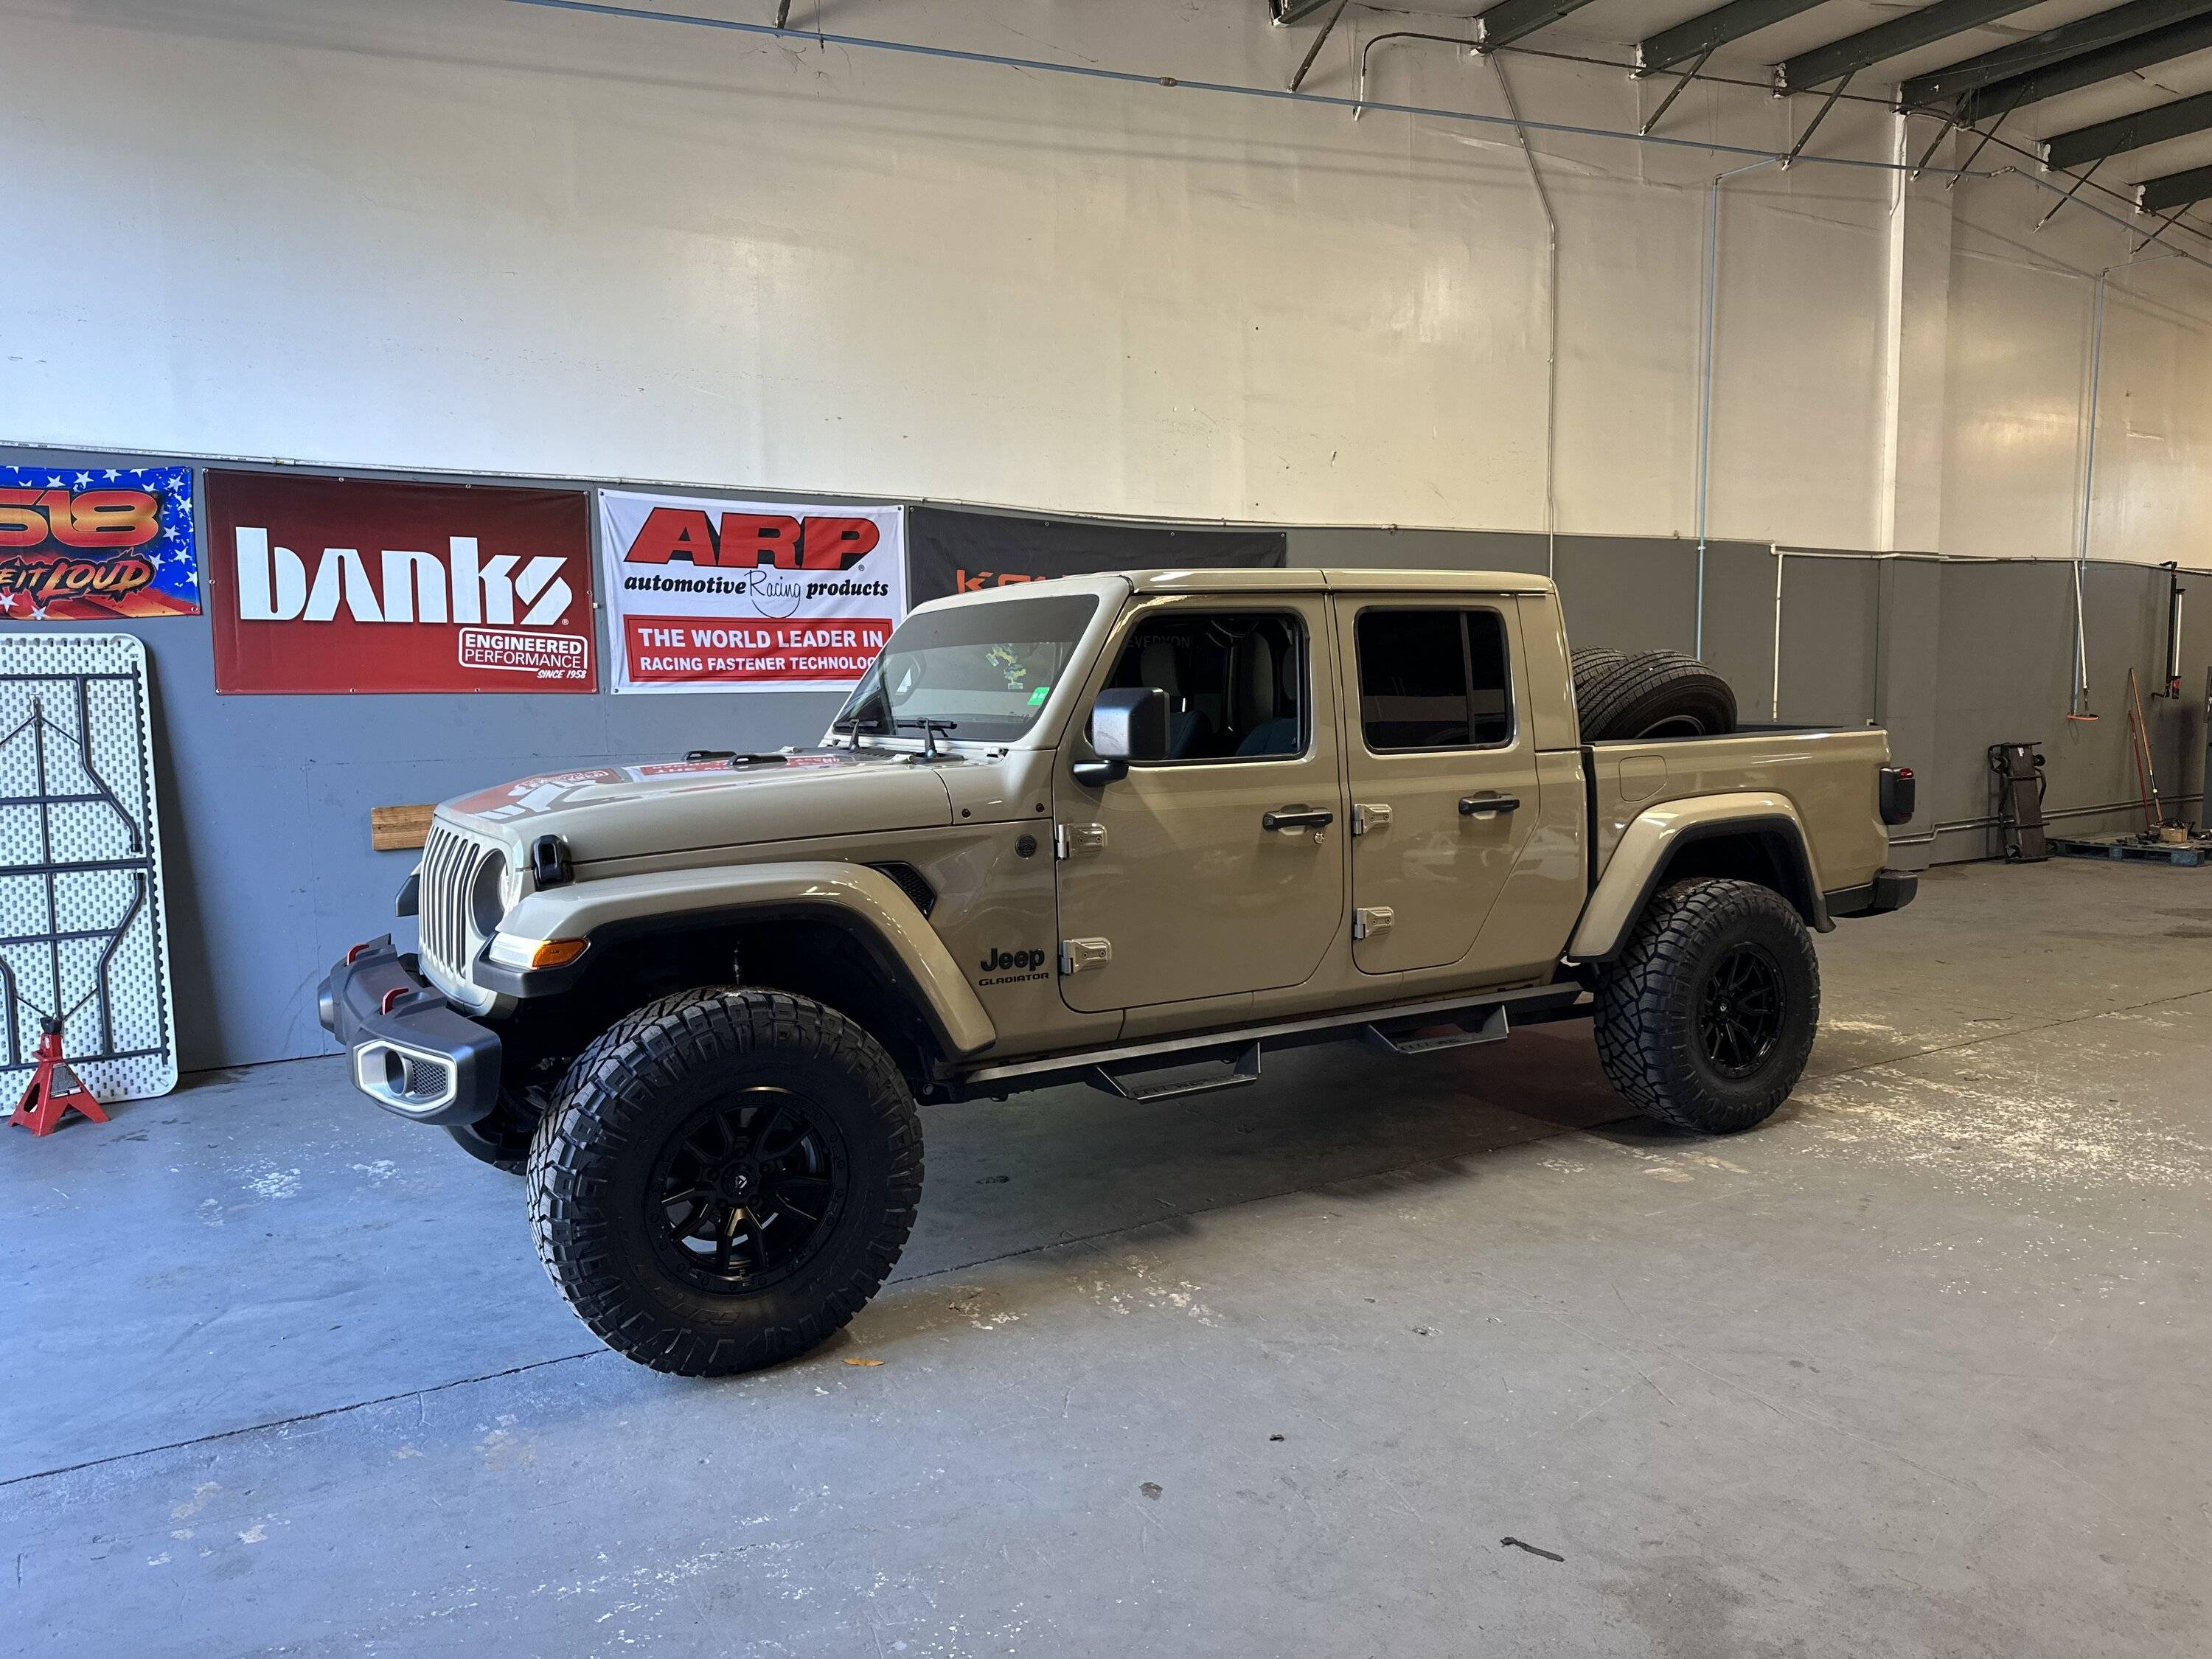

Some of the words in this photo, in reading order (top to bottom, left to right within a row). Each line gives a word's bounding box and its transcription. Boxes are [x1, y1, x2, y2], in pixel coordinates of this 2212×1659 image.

[624, 507, 880, 571] ARP
[37, 559, 151, 599] LOUD
[236, 526, 573, 625] banks
[624, 574, 746, 594] automotive
[745, 569, 801, 619] Racing
[805, 579, 889, 599] products
[465, 633, 582, 655] ENGINEERED
[638, 628, 686, 647] THE
[692, 629, 771, 648] WORLD
[776, 630, 858, 647] LEADER
[862, 630, 883, 648] IN
[465, 648, 581, 669] PERFORMANCE
[640, 656, 703, 671] RACING
[707, 657, 786, 671] FASTENER
[537, 669, 564, 679] SINCE
[566, 670, 587, 679] 1958
[980, 947, 1046, 972] Jeep
[978, 972, 1050, 987] GLADIATOR
